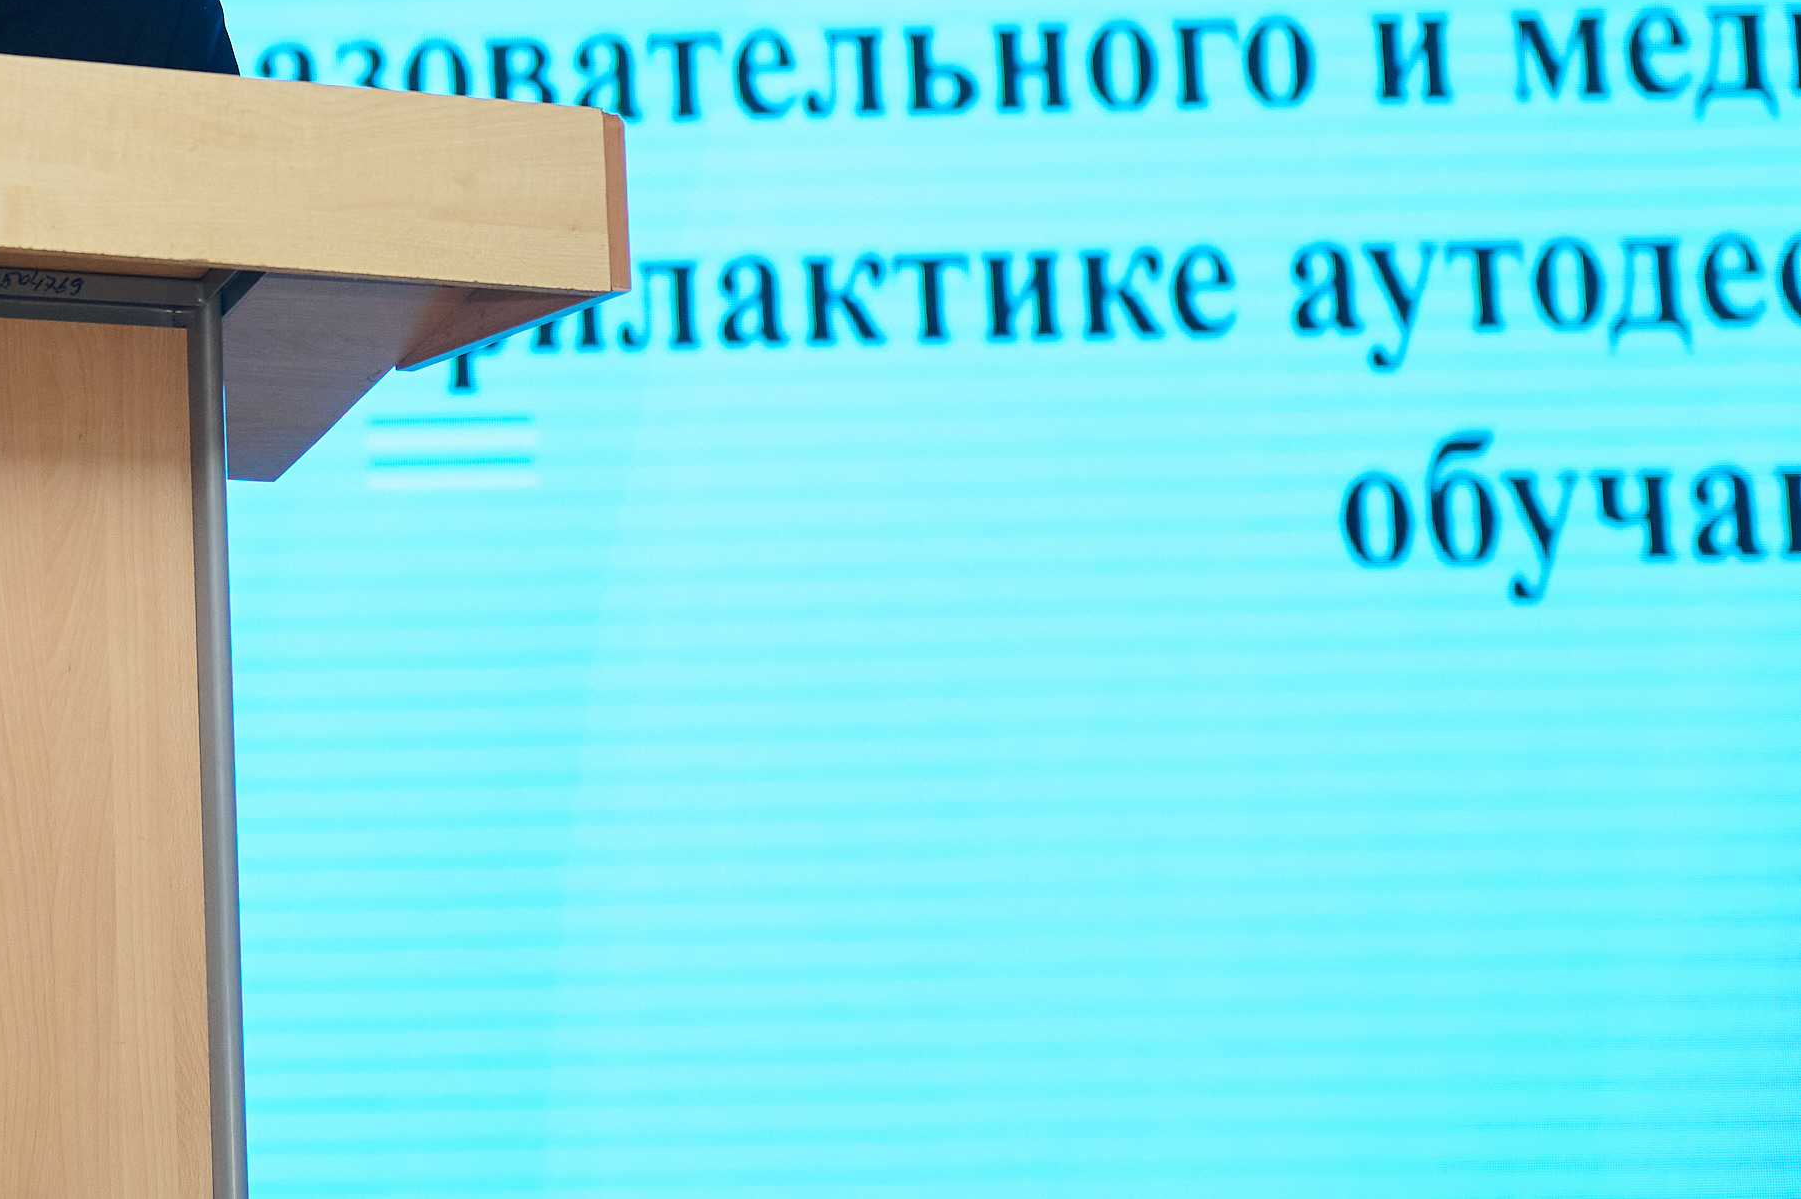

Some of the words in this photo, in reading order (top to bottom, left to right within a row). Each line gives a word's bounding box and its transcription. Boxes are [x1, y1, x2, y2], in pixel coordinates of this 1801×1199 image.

[1373, 13, 1451, 104] и
[1513, 4, 1801, 115] мед
[1340, 430, 1801, 604] обуча
